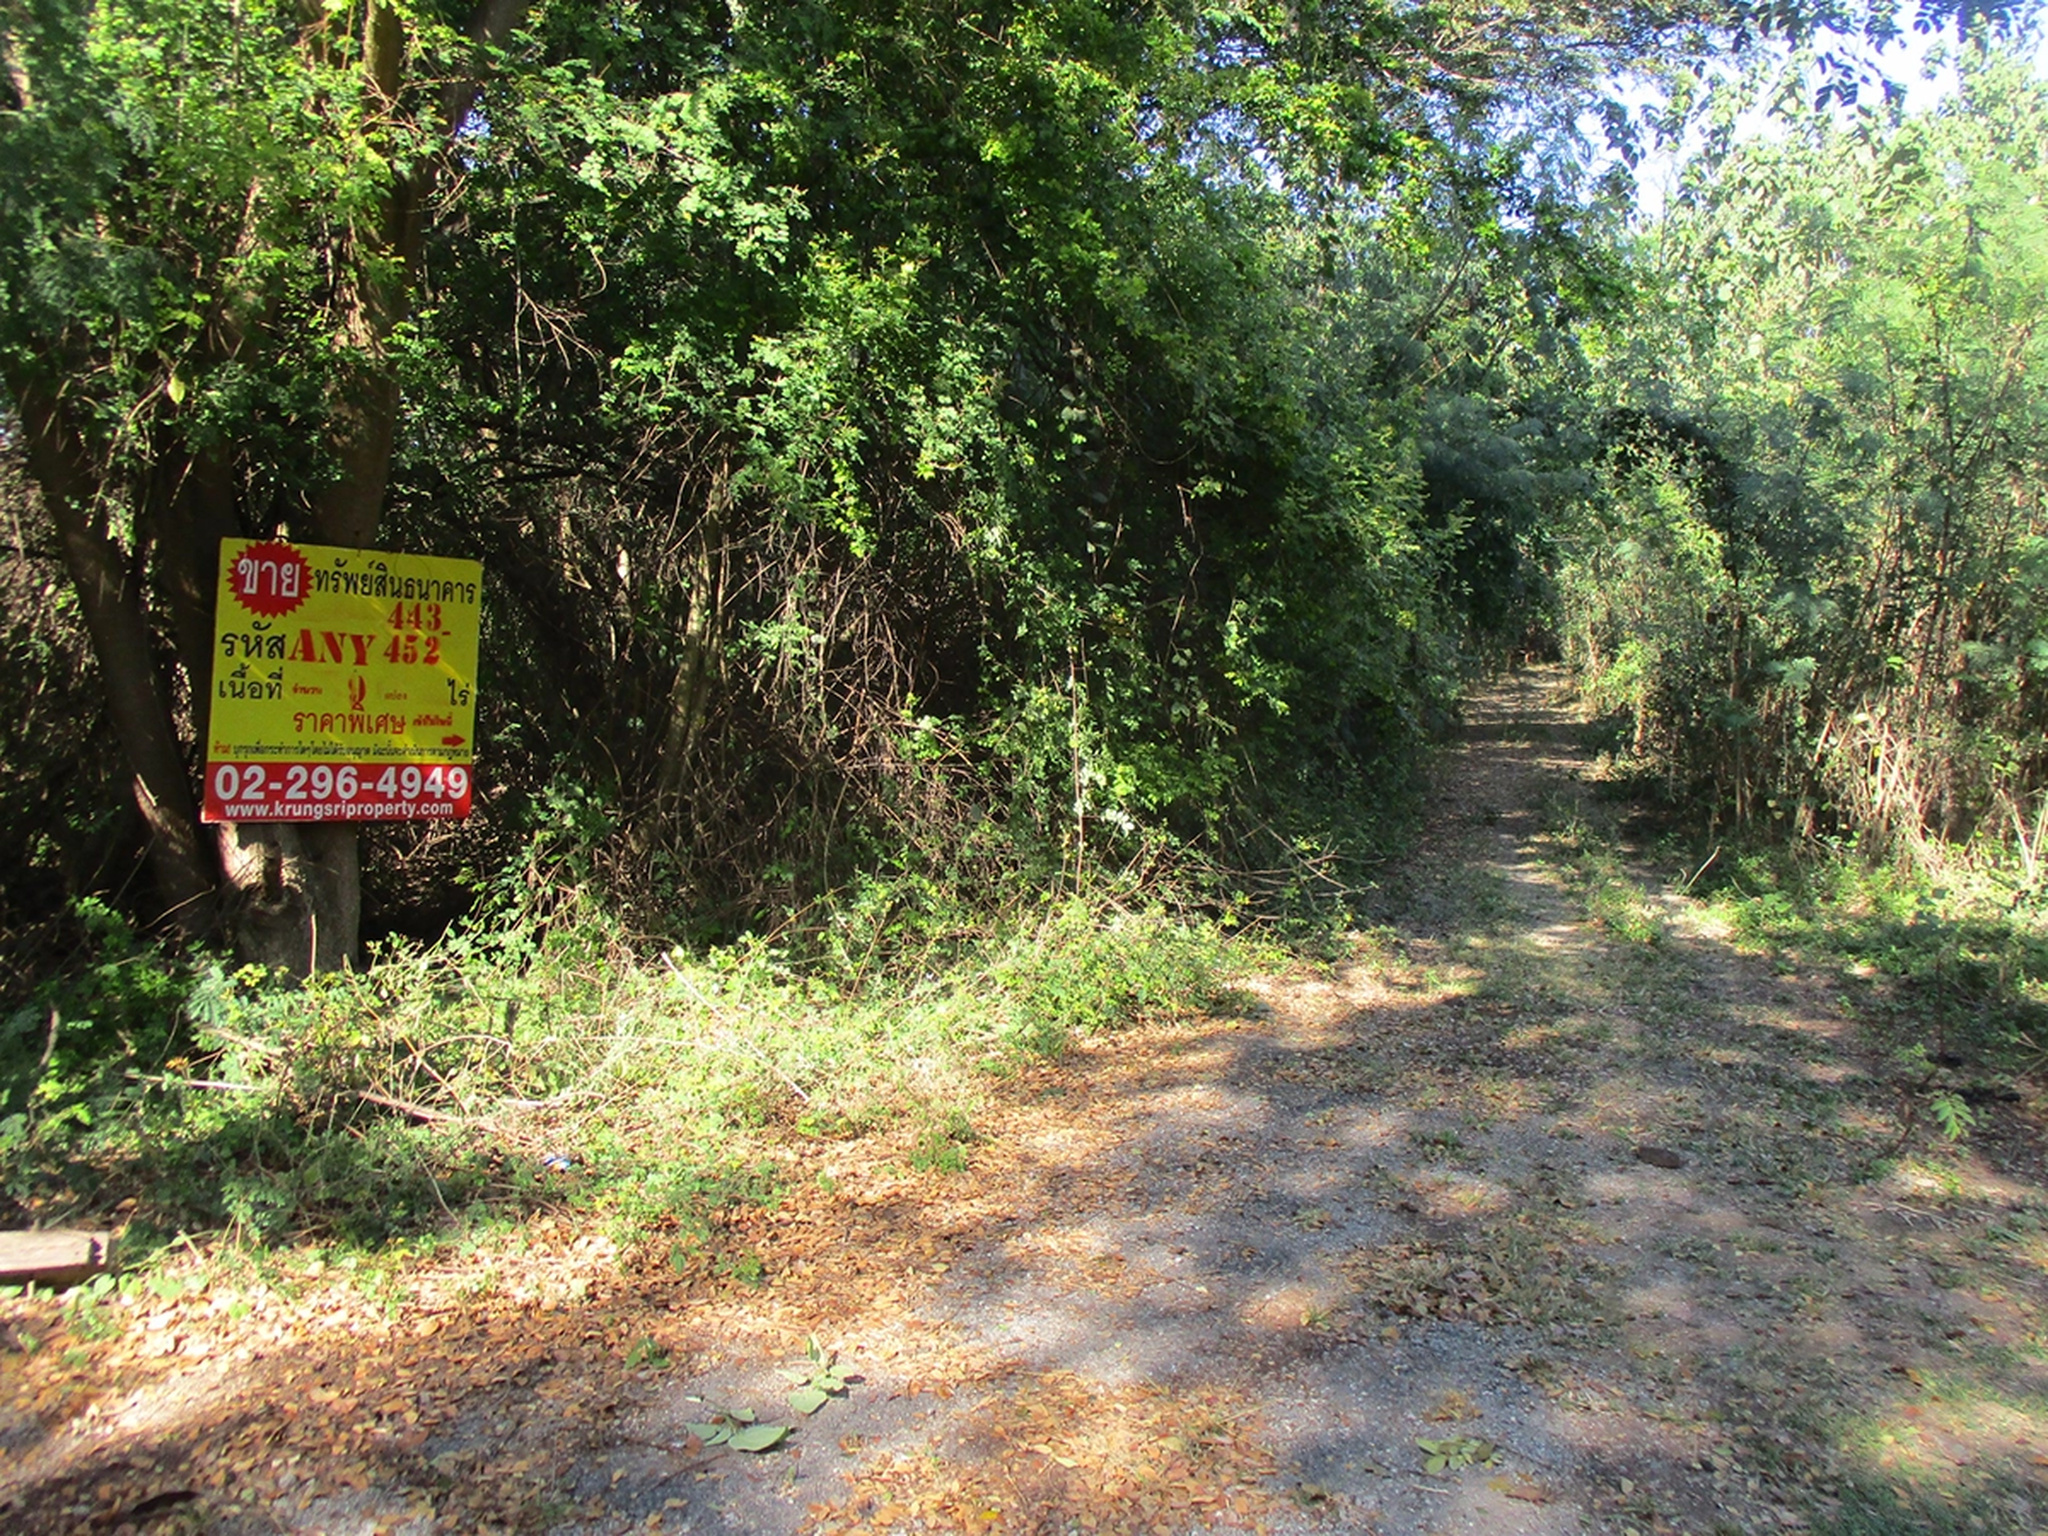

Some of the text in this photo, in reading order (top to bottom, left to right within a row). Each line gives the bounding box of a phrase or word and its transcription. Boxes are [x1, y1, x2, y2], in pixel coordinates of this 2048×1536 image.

[238, 555, 301, 598] ขาย
[314, 558, 477, 604] ทรัพย์สินธนาคาร
[221, 620, 442, 666] รหัส ANY 452
[218, 664, 283, 700] เนื้อที่
[447, 677, 470, 706] ไร่
[293, 704, 407, 735] ราคาพิเศษ
[214, 765, 469, 800] 02-296-4949
[225, 800, 453, 820] www.krungsriproperty.com
